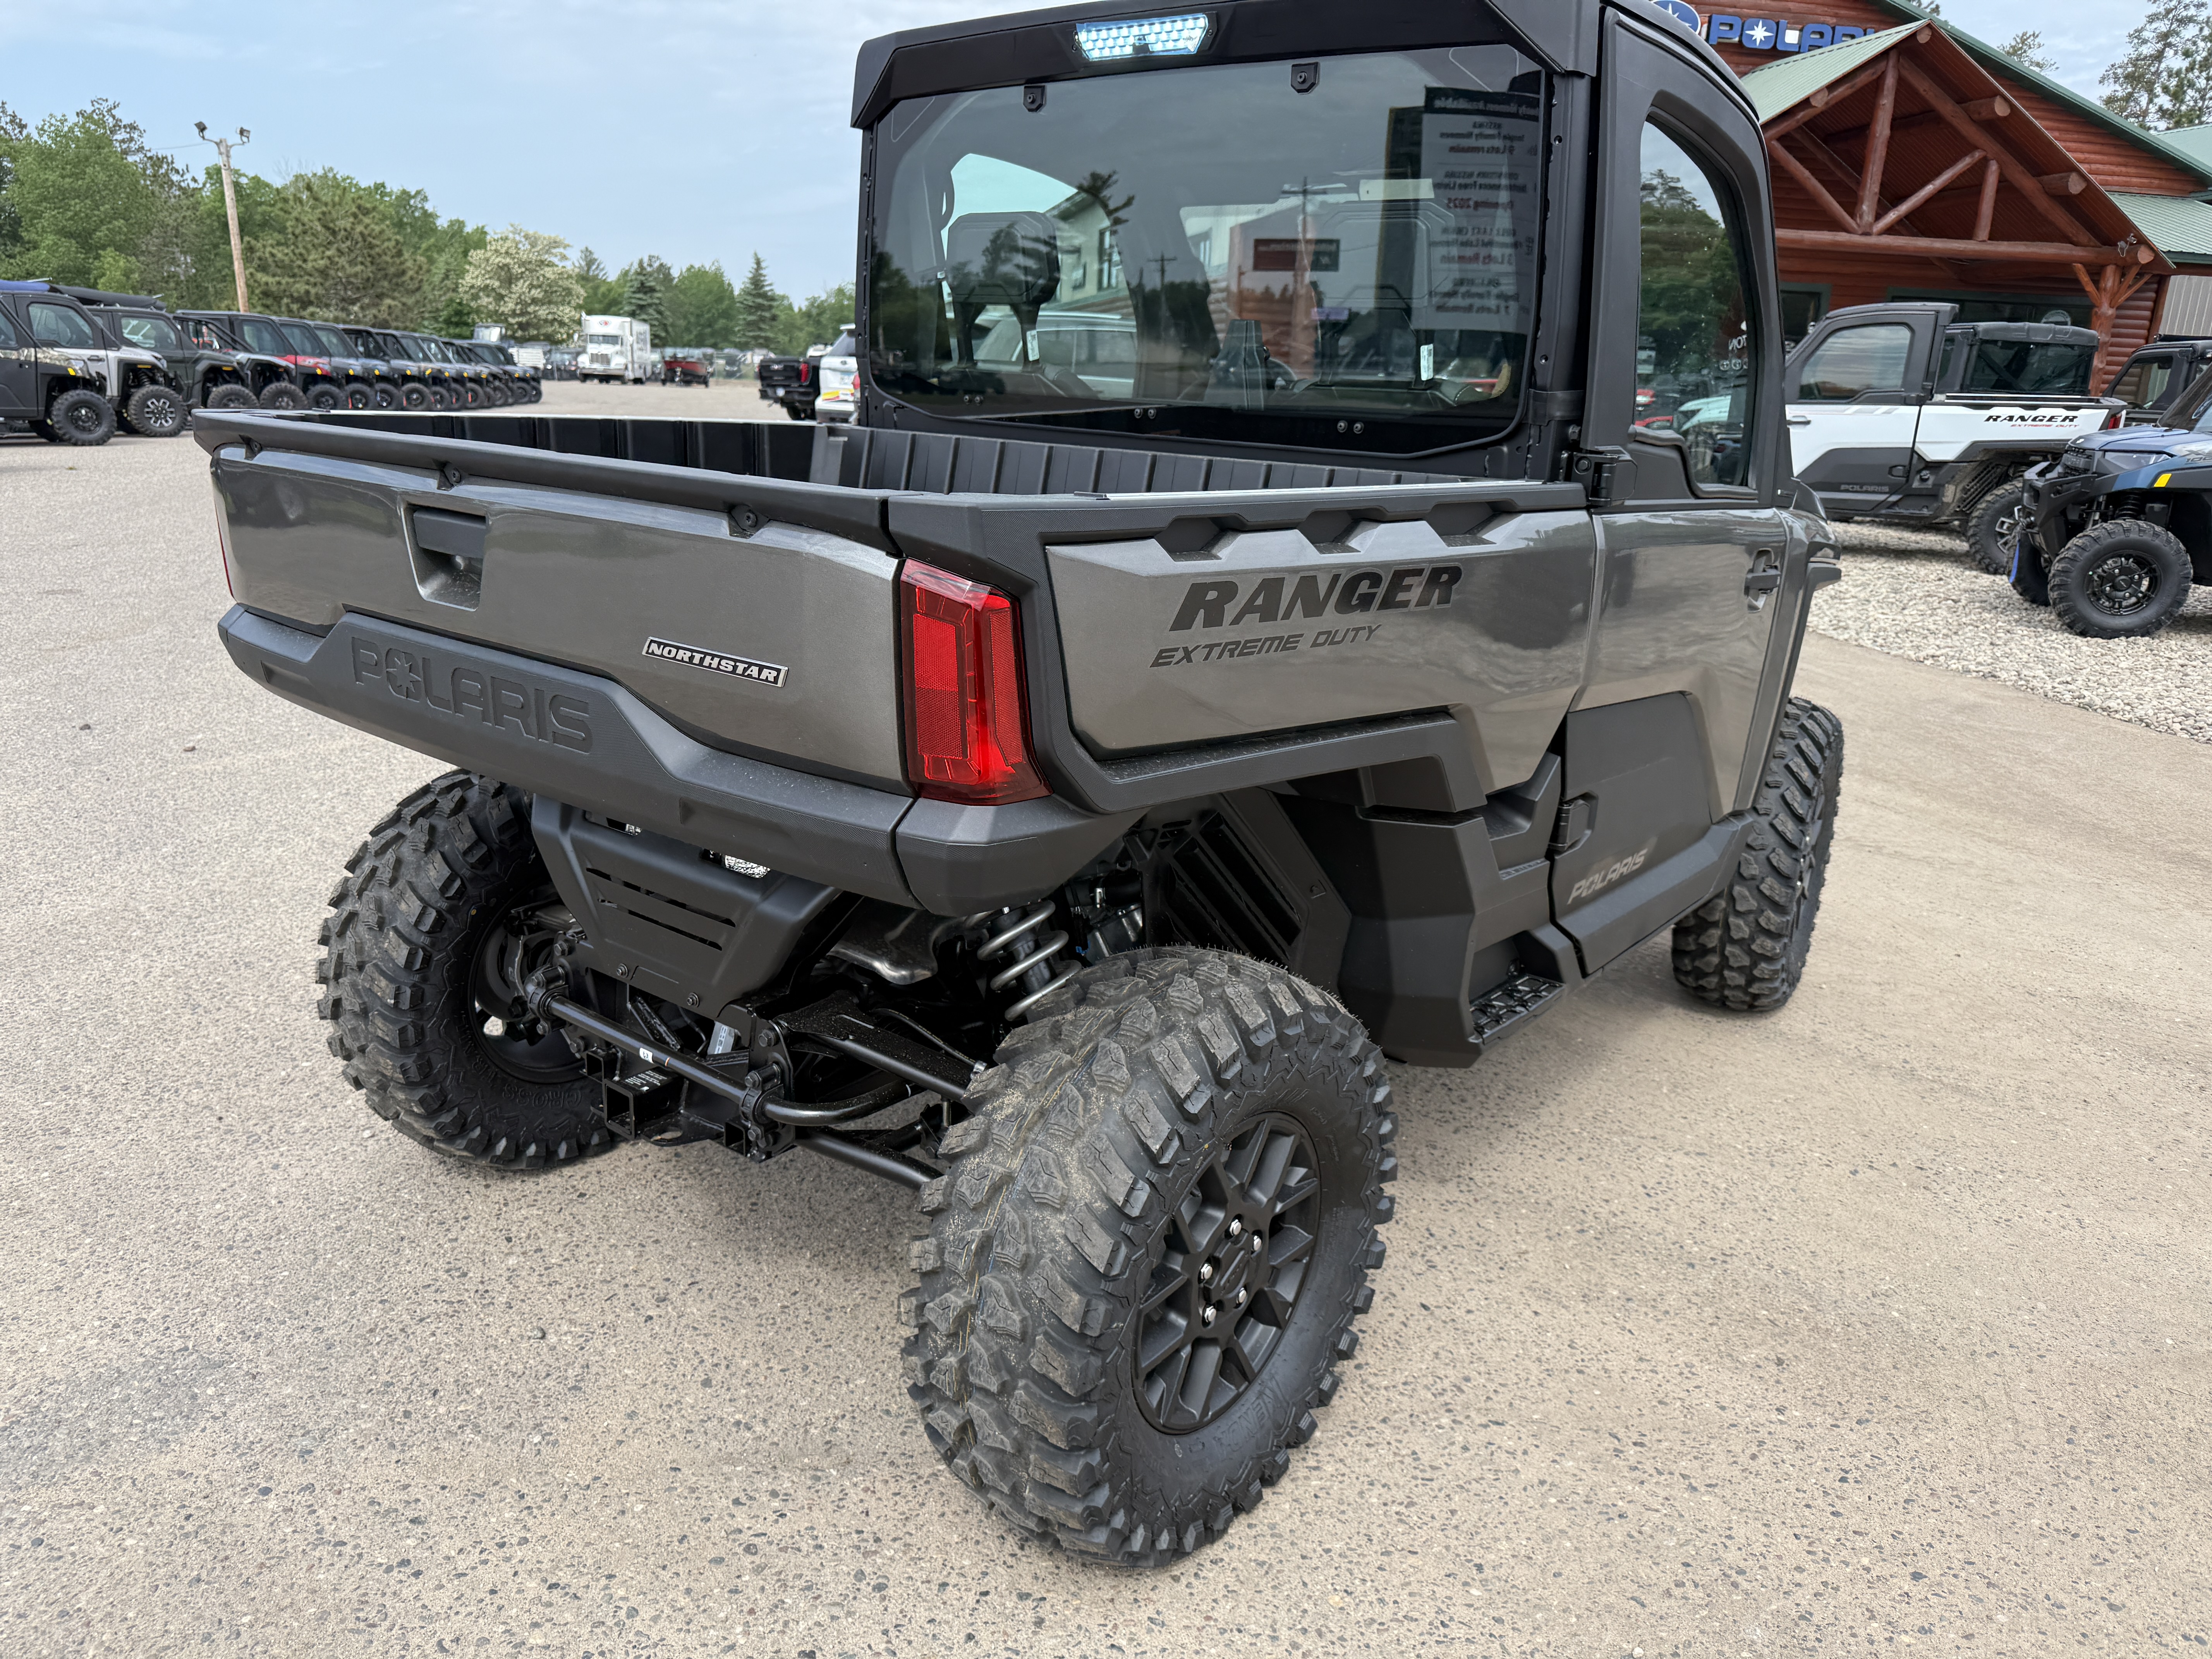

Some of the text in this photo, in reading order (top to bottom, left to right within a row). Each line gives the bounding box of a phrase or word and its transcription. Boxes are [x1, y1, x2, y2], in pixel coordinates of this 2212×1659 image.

[1169, 563, 1463, 632] RANGER
[648, 642, 778, 682] NORTHSTAR
[1149, 623, 1382, 668] EXTREME DUTY
[351, 637, 593, 755] POLARIS
[1567, 848, 1648, 905] POLARIS
[502, 1083, 582, 1109] CROSS
